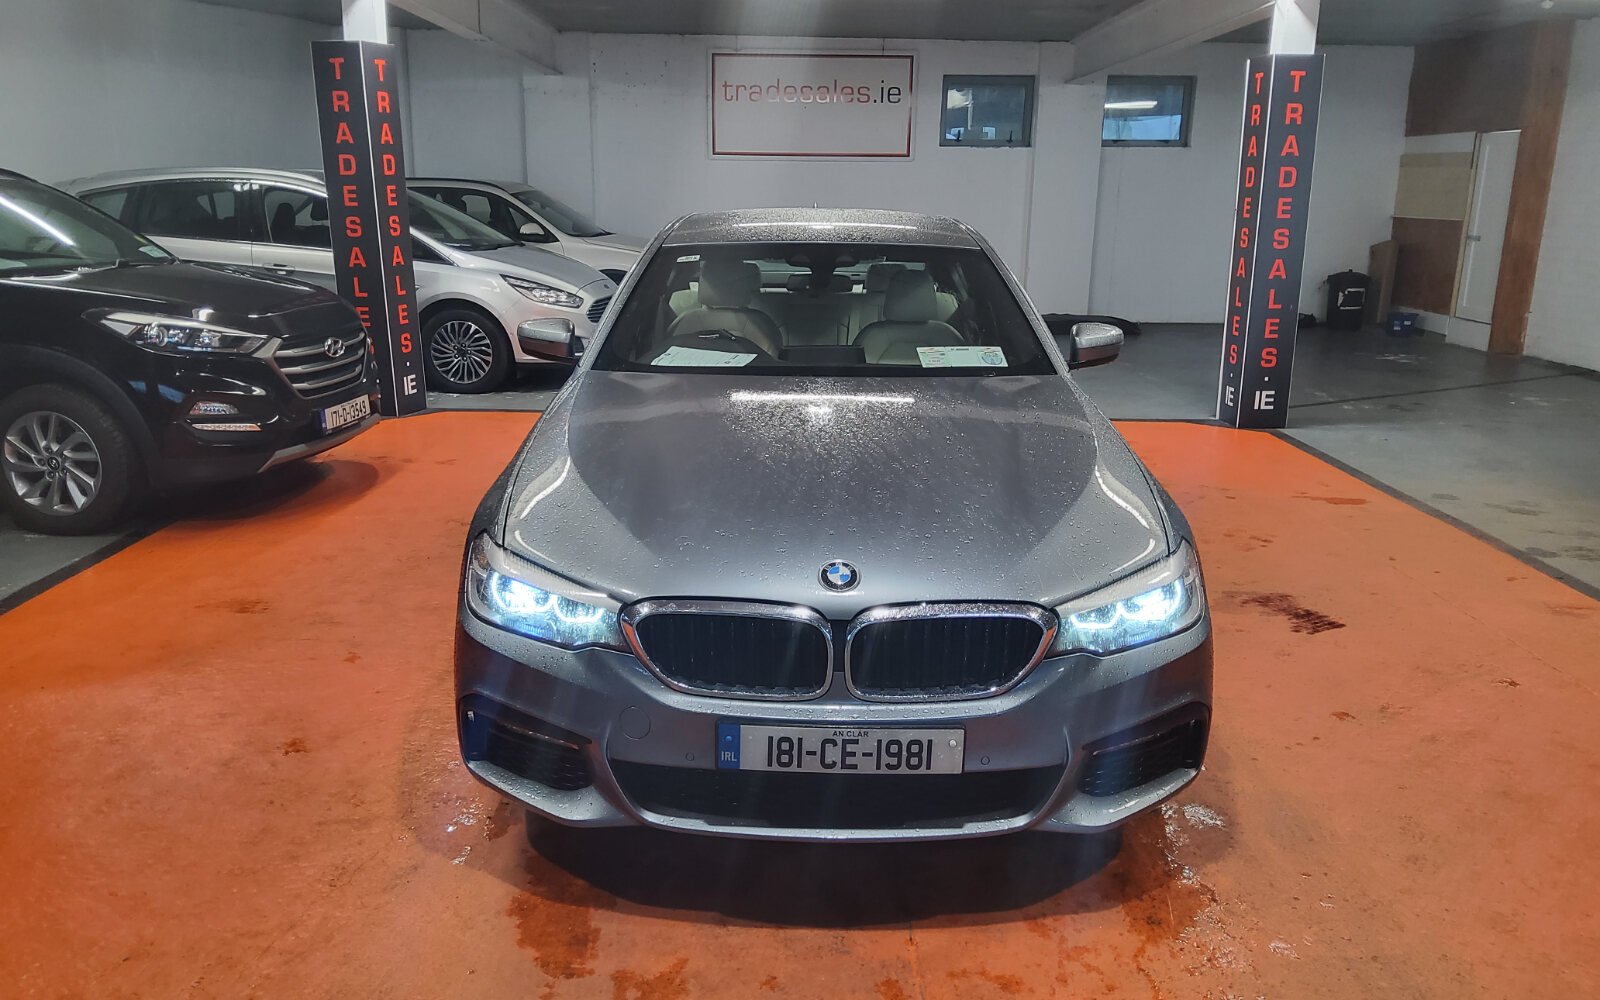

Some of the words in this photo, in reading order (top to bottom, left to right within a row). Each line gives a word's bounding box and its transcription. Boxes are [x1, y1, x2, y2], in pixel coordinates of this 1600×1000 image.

[722, 78, 902, 104] tradesales.ie
[329, 57, 375, 355] TRADESALE
[832, 730, 844, 738] AN
[721, 751, 737, 762] IRL
[766, 735, 933, 771] 181-CE-1981
